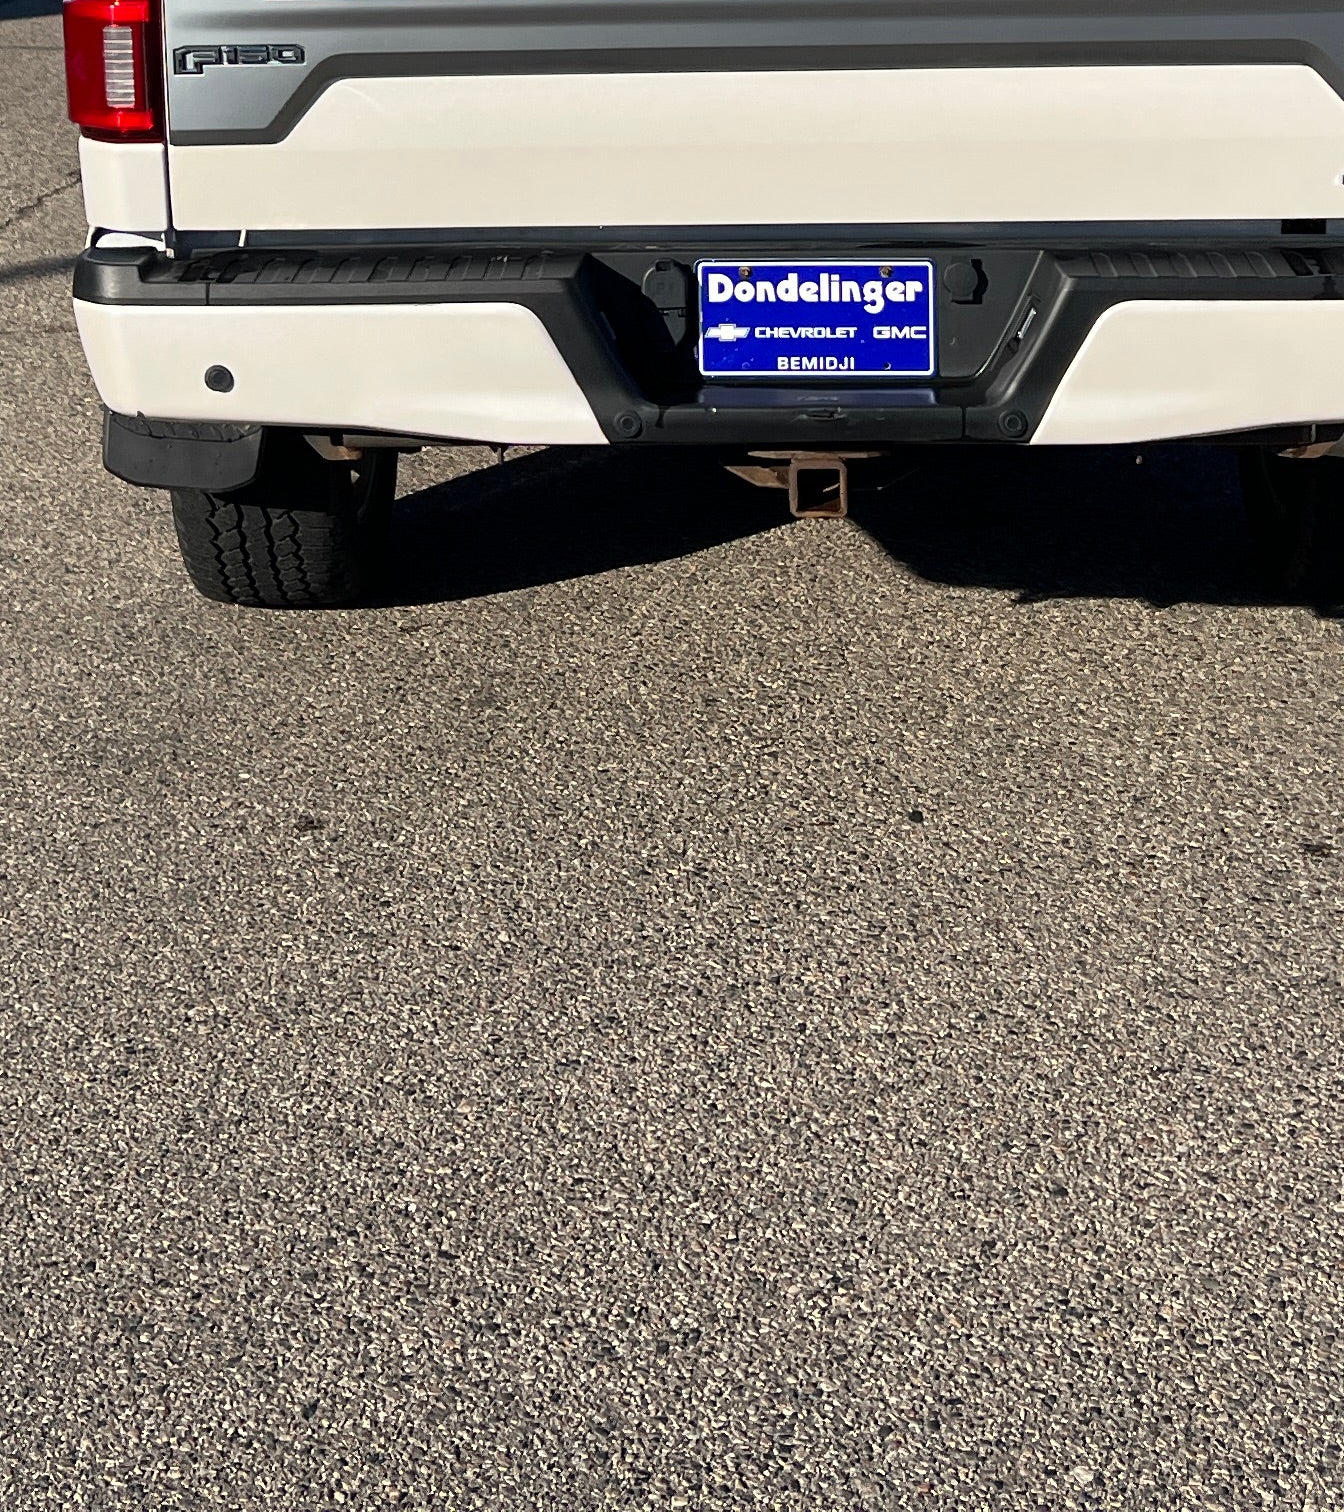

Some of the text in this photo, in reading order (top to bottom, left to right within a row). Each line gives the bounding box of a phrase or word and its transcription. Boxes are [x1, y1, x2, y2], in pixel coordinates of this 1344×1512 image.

[707, 272, 923, 314] Dondelinger
[754, 326, 927, 339] CHEVROLET GMC
[777, 356, 855, 370] BEMIDJI
